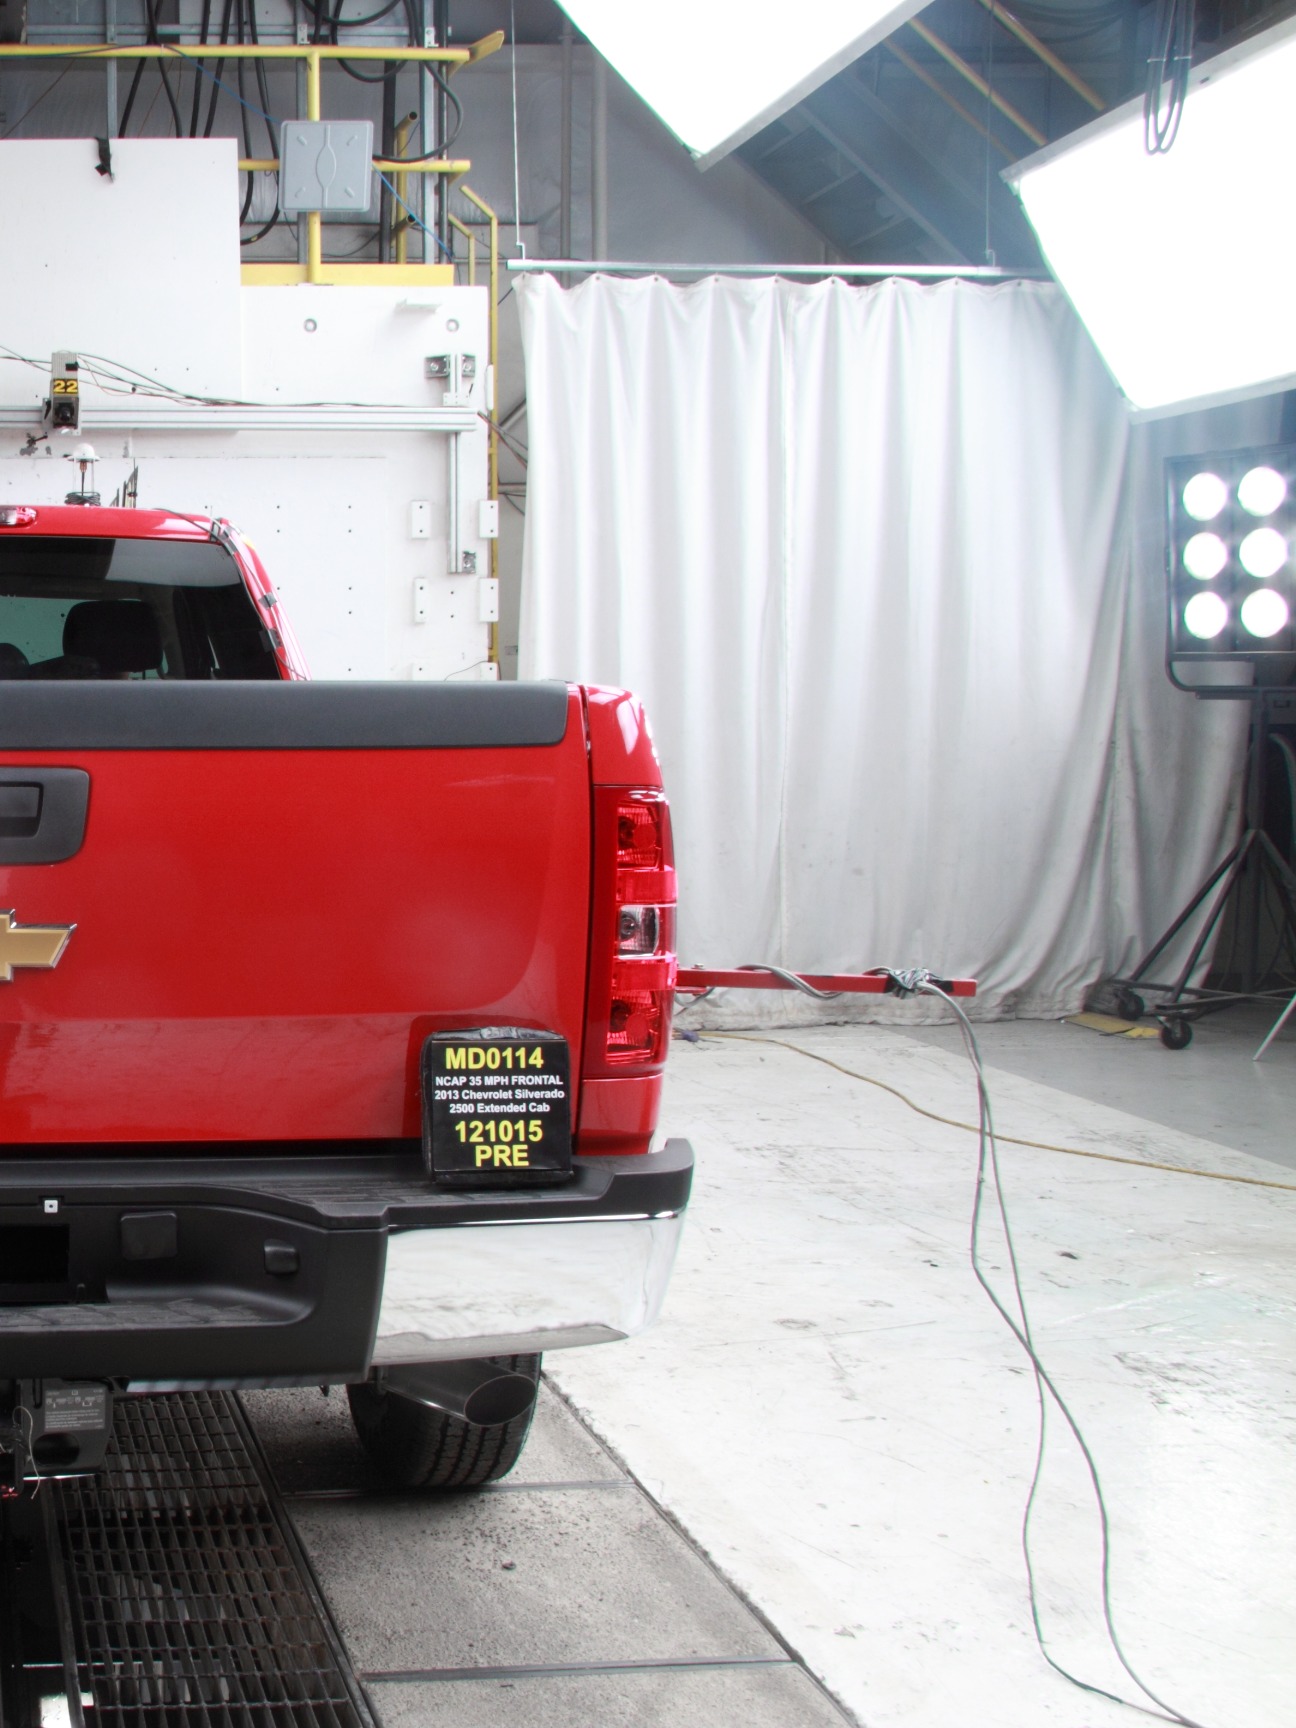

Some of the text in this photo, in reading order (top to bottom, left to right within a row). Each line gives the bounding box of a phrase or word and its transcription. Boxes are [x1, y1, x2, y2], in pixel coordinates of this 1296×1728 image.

[54, 380, 78, 393] 22
[445, 1047, 544, 1070] MD0114
[435, 1075, 564, 1087] NCAP 35 MPH FRONTAL
[435, 1089, 565, 1100] 2013 Chevrolet Silverado
[449, 1102, 550, 1114] 2500 Extended Cab
[455, 1120, 543, 1143] 121015
[475, 1144, 530, 1168] PRE
